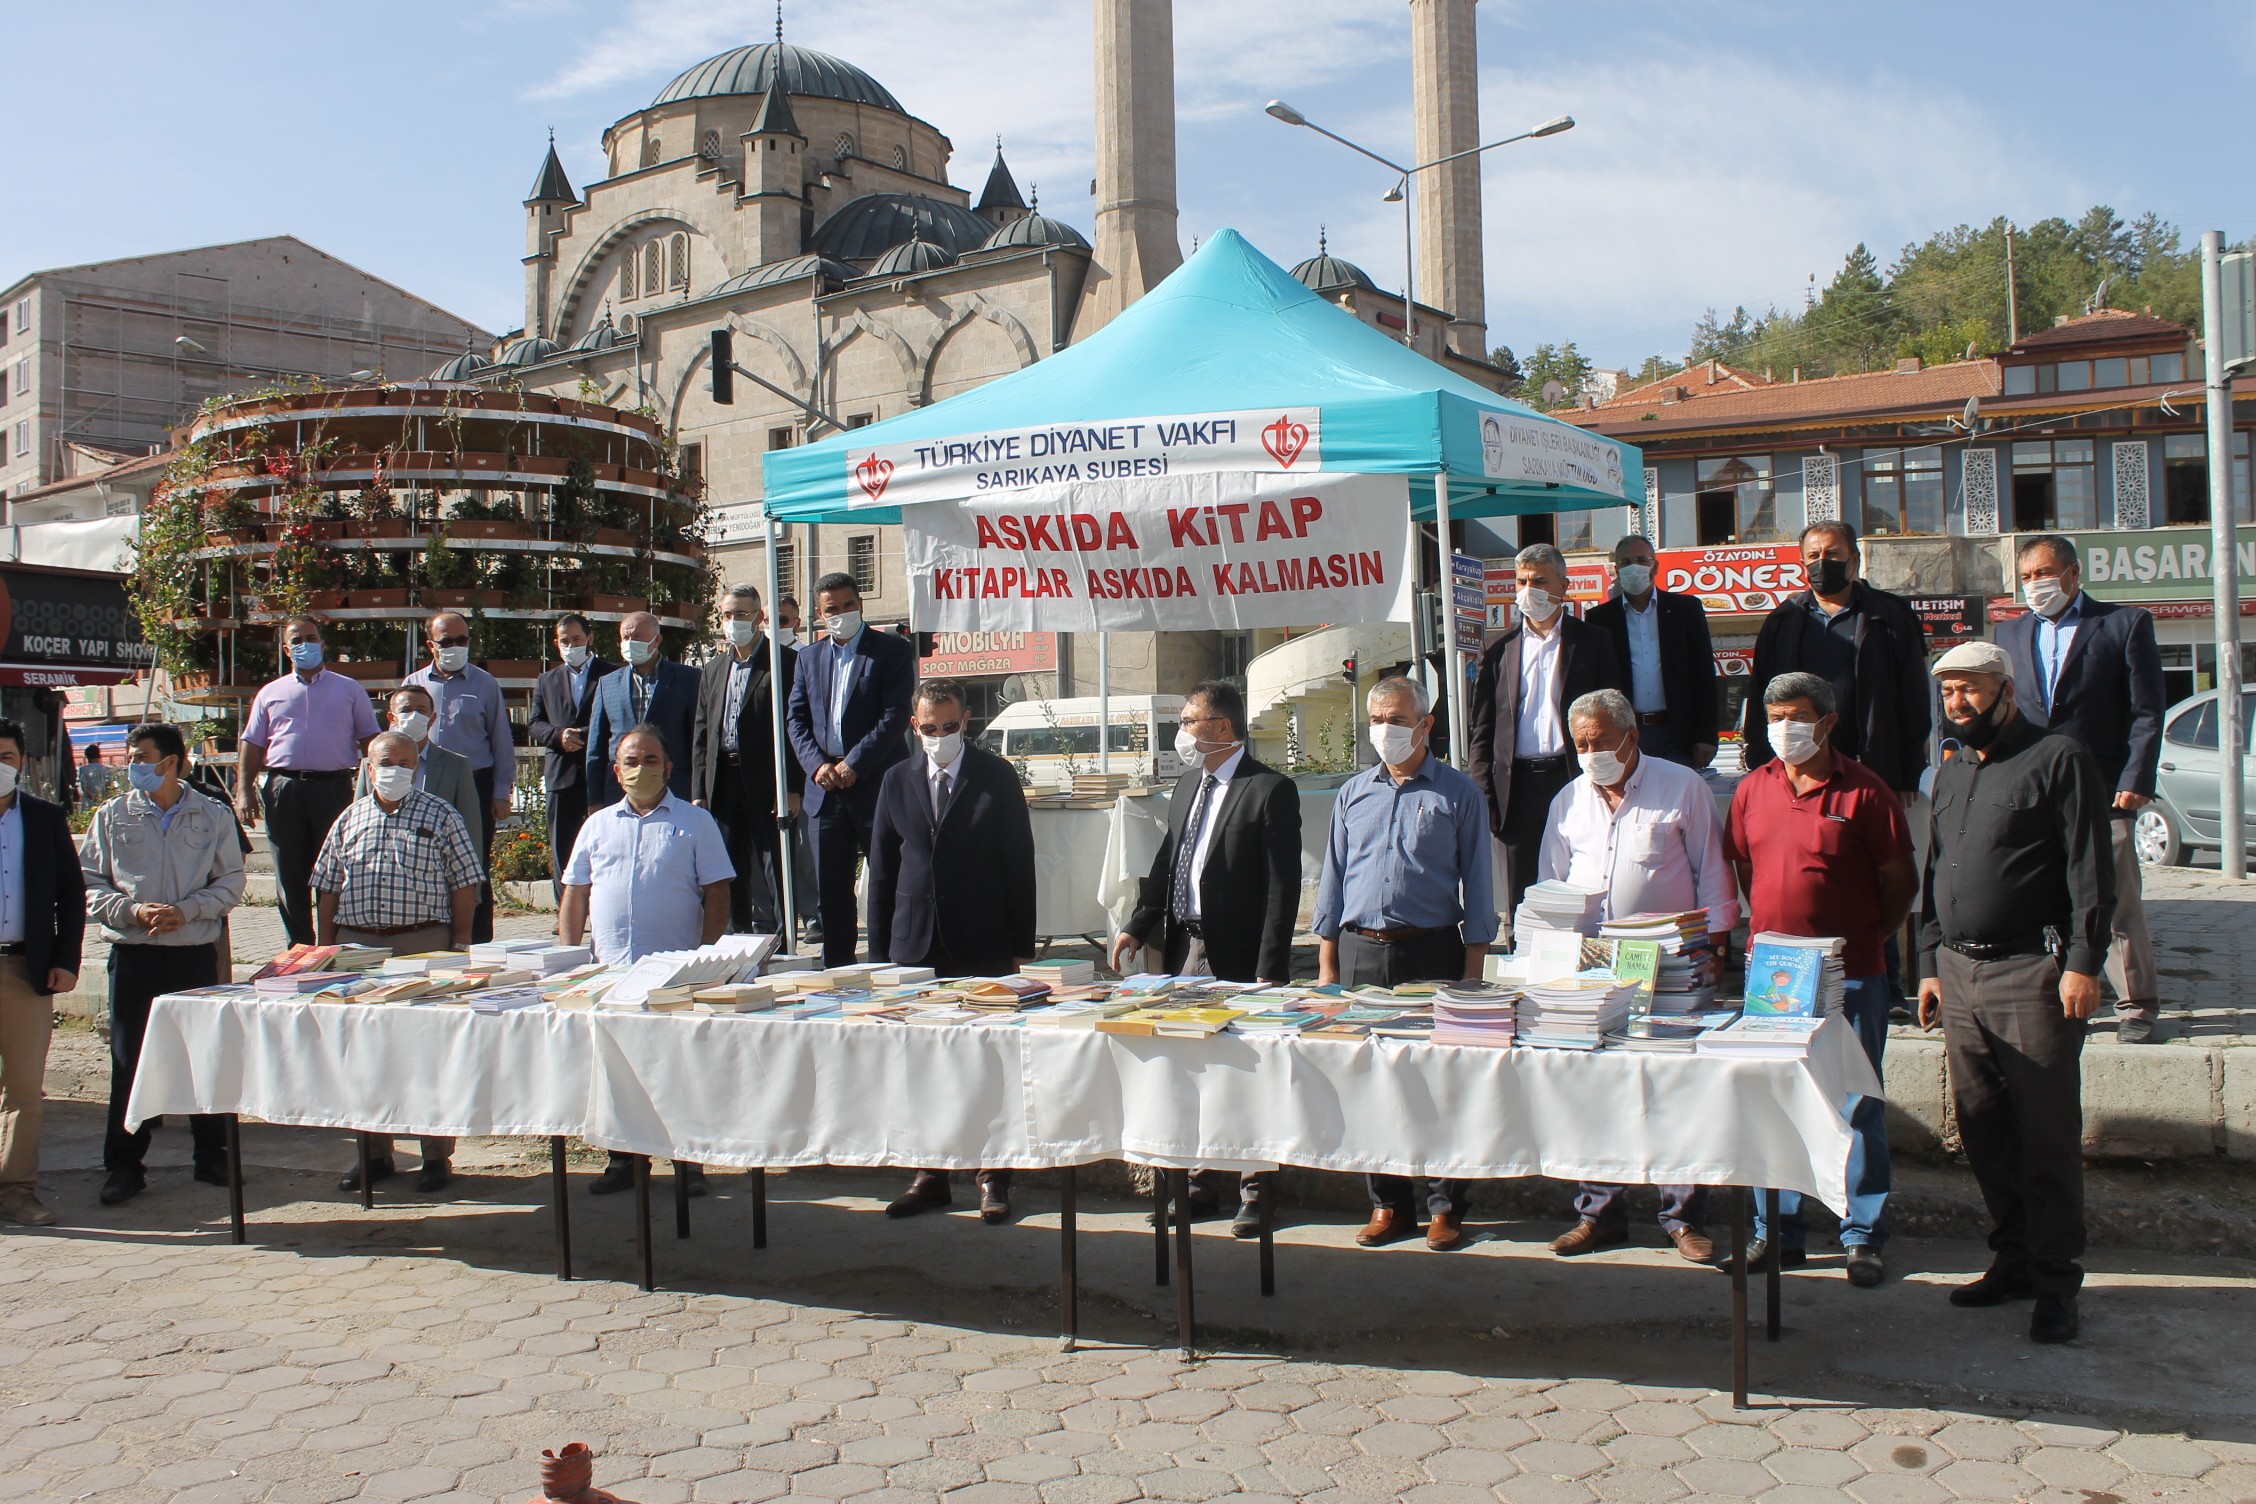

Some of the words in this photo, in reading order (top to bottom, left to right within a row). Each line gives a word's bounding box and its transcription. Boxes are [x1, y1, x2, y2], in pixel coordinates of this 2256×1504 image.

[914, 435, 1020, 469] TÜRKİYE
[1031, 425, 1145, 457] DİYANET
[1157, 420, 1236, 447] VAKFI
[976, 464, 1080, 490] SARIKAYA
[1087, 453, 1168, 481] ŞUBESİ
[976, 511, 1139, 551] ASKIDA
[1704, 550, 1765, 562] ÖZAYDIN
[2088, 542, 2256, 584] BAŞARN
[1088, 565, 1197, 599] ASKIDA
[1212, 550, 1384, 596] KALMASIN
[1456, 561, 1482, 576] Karayakup
[1667, 563, 1806, 592] DÖNER
[1459, 622, 1474, 633] Roma
[23, 635, 70, 657] KOÇER
[79, 639, 109, 657] YAPI
[923, 660, 954, 674] SPOT
[957, 656, 1012, 672] MAĞAZA
[23, 671, 78, 686] SERAMİK
[1627, 961, 1650, 970] NAMAZ
